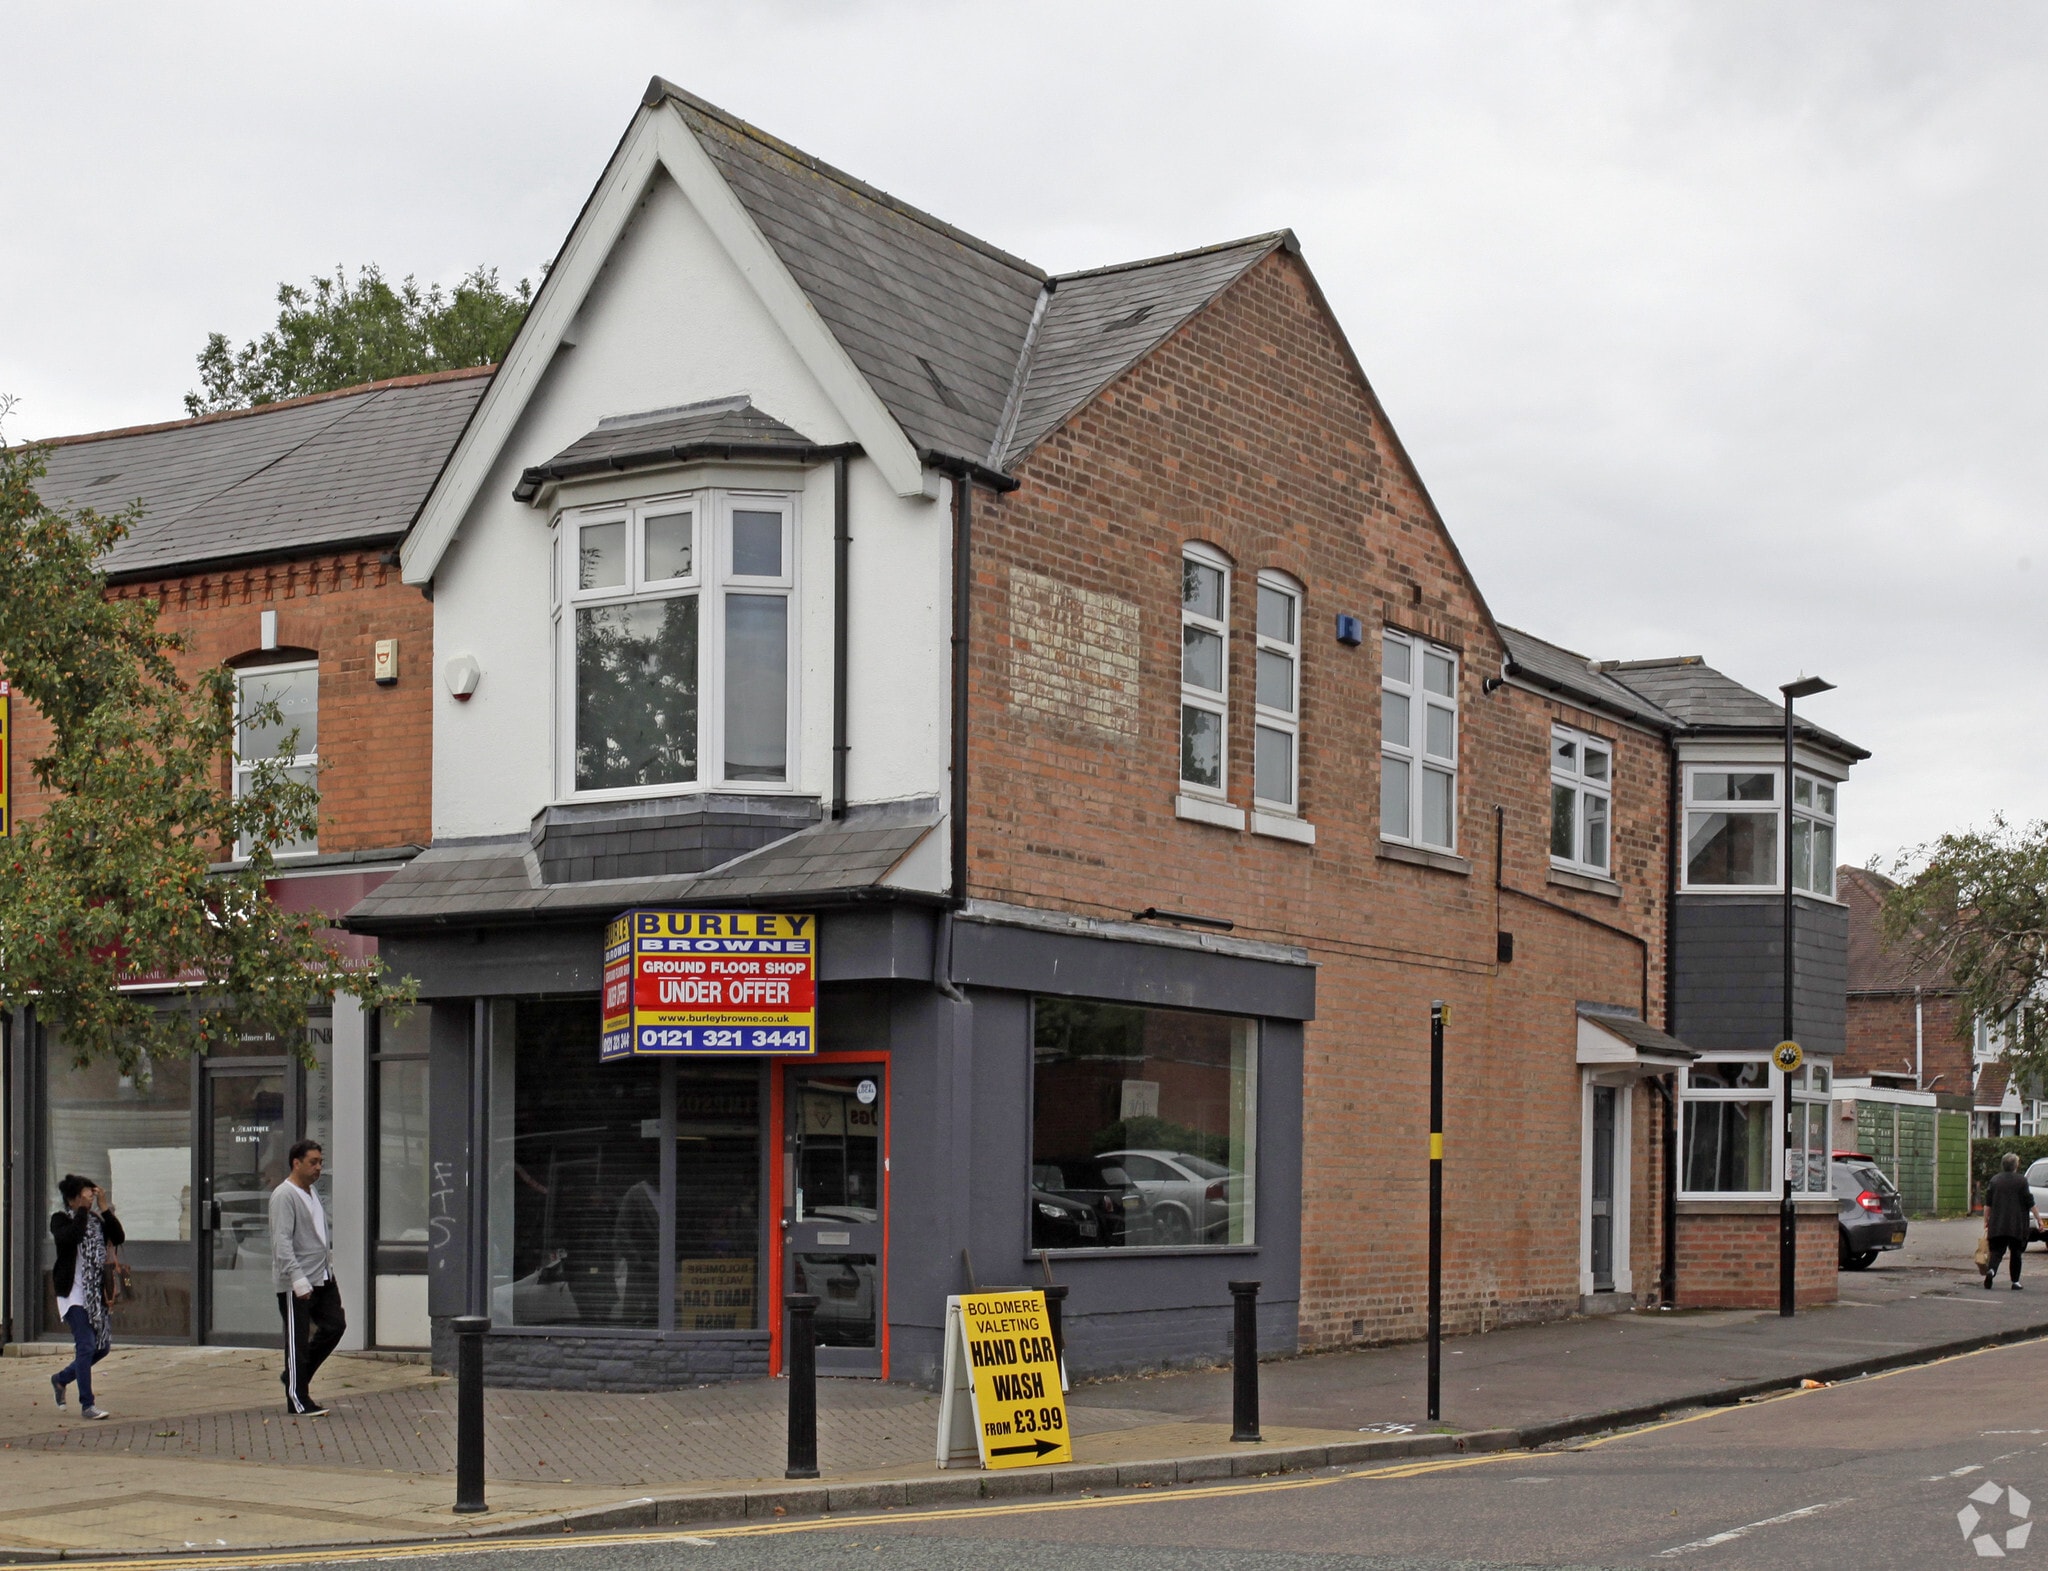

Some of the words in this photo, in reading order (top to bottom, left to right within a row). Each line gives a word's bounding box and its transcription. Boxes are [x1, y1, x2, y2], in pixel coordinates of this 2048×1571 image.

[637, 914, 809, 935] BURLEY
[642, 940, 806, 952] BROWNE
[643, 961, 706, 974] GROUND
[711, 961, 760, 974] FLOOR
[765, 962, 806, 975] SHOP
[659, 980, 722, 1004] UNDER
[729, 981, 790, 1004] OFFER
[658, 1014, 789, 1024] www.burleybrowne.co.uk
[642, 1030, 692, 1047] 0121
[703, 1030, 742, 1047] 321
[752, 1030, 806, 1047] 3441
[968, 1300, 1040, 1315] BOLDMERE
[976, 1318, 1039, 1333] VALETING
[970, 1339, 1018, 1367] HAND
[1019, 1336, 1054, 1363] CAR
[992, 1372, 1045, 1402] WASH
[985, 1422, 1011, 1436] FROM
[1014, 1407, 1063, 1433] £3.99
